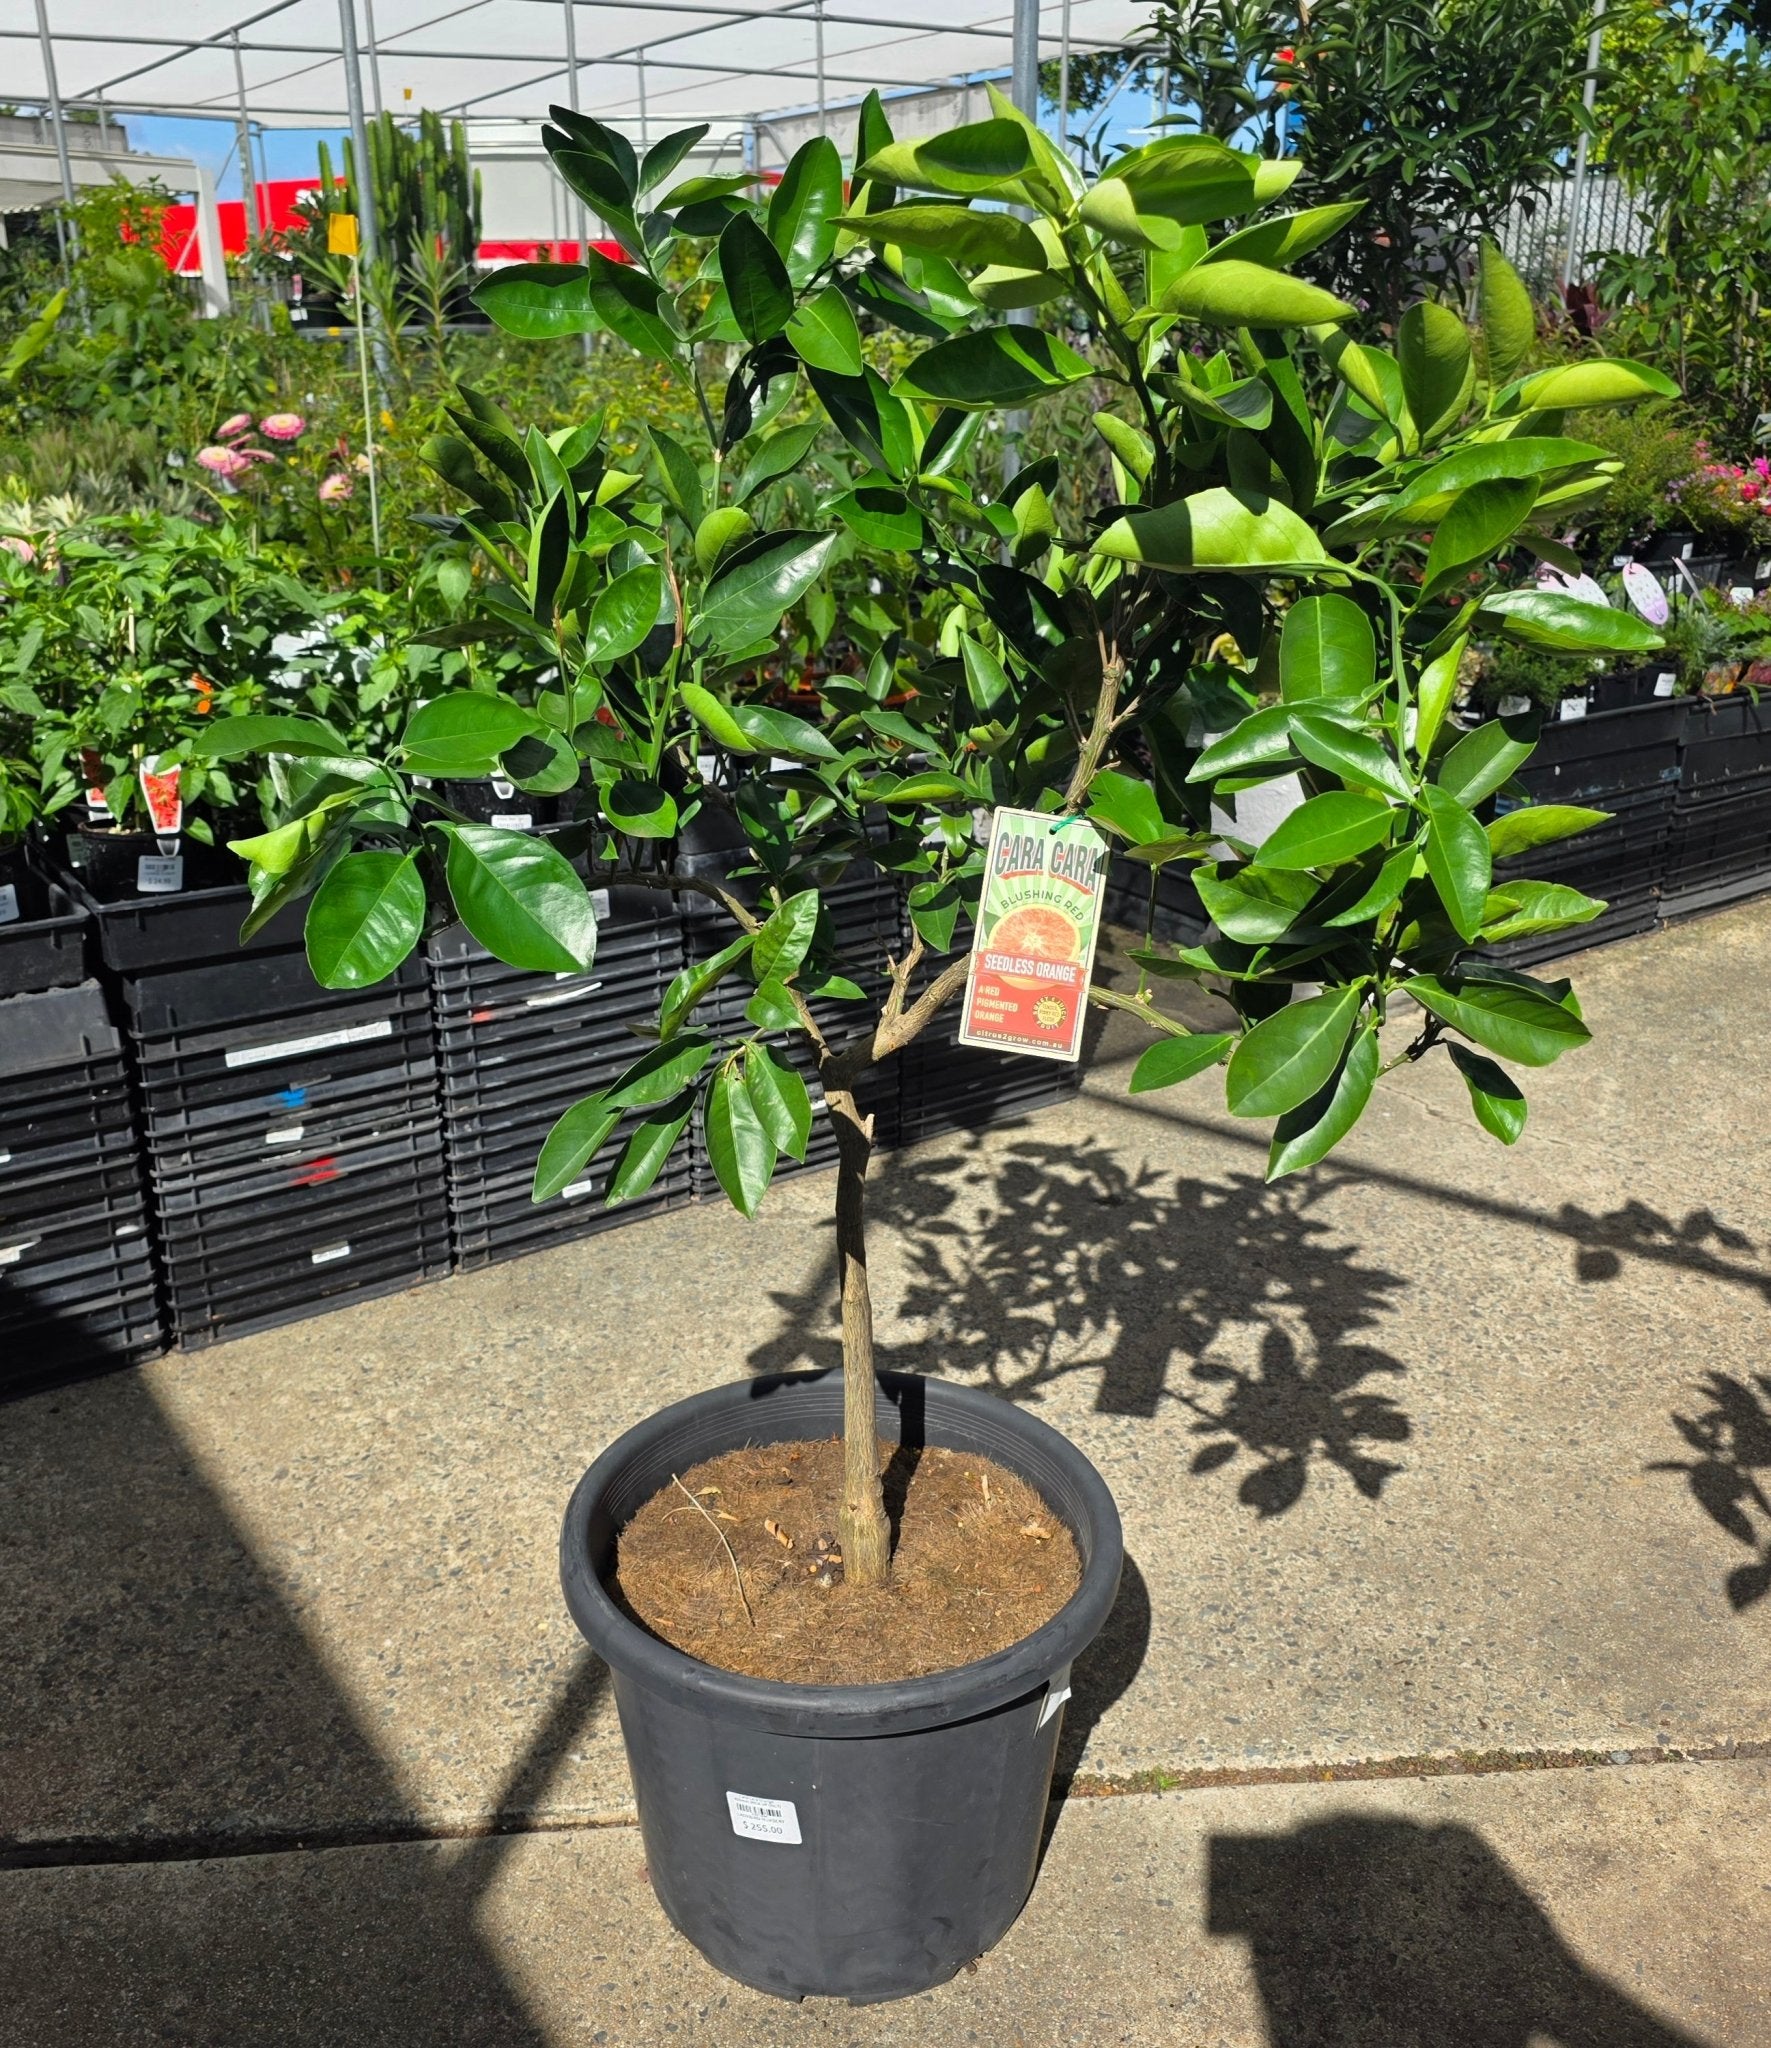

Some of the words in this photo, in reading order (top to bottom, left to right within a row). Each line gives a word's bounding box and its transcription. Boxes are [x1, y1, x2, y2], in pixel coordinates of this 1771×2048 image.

[994, 832, 1045, 875] CARA
[1050, 841, 1098, 892] CARA
[1000, 889, 1062, 910] BLUSHING
[1063, 900, 1085, 921] RED
[984, 953, 1035, 976] SEEDLESS
[1036, 962, 1078, 983] ORANGE
[978, 985, 984, 994] A
[984, 986, 1000, 997] RED
[976, 997, 1019, 1013] PIGMENTED
[974, 1010, 1005, 1023] ORANGE
[976, 1029, 1063, 1049] citrus2grow.com.au
